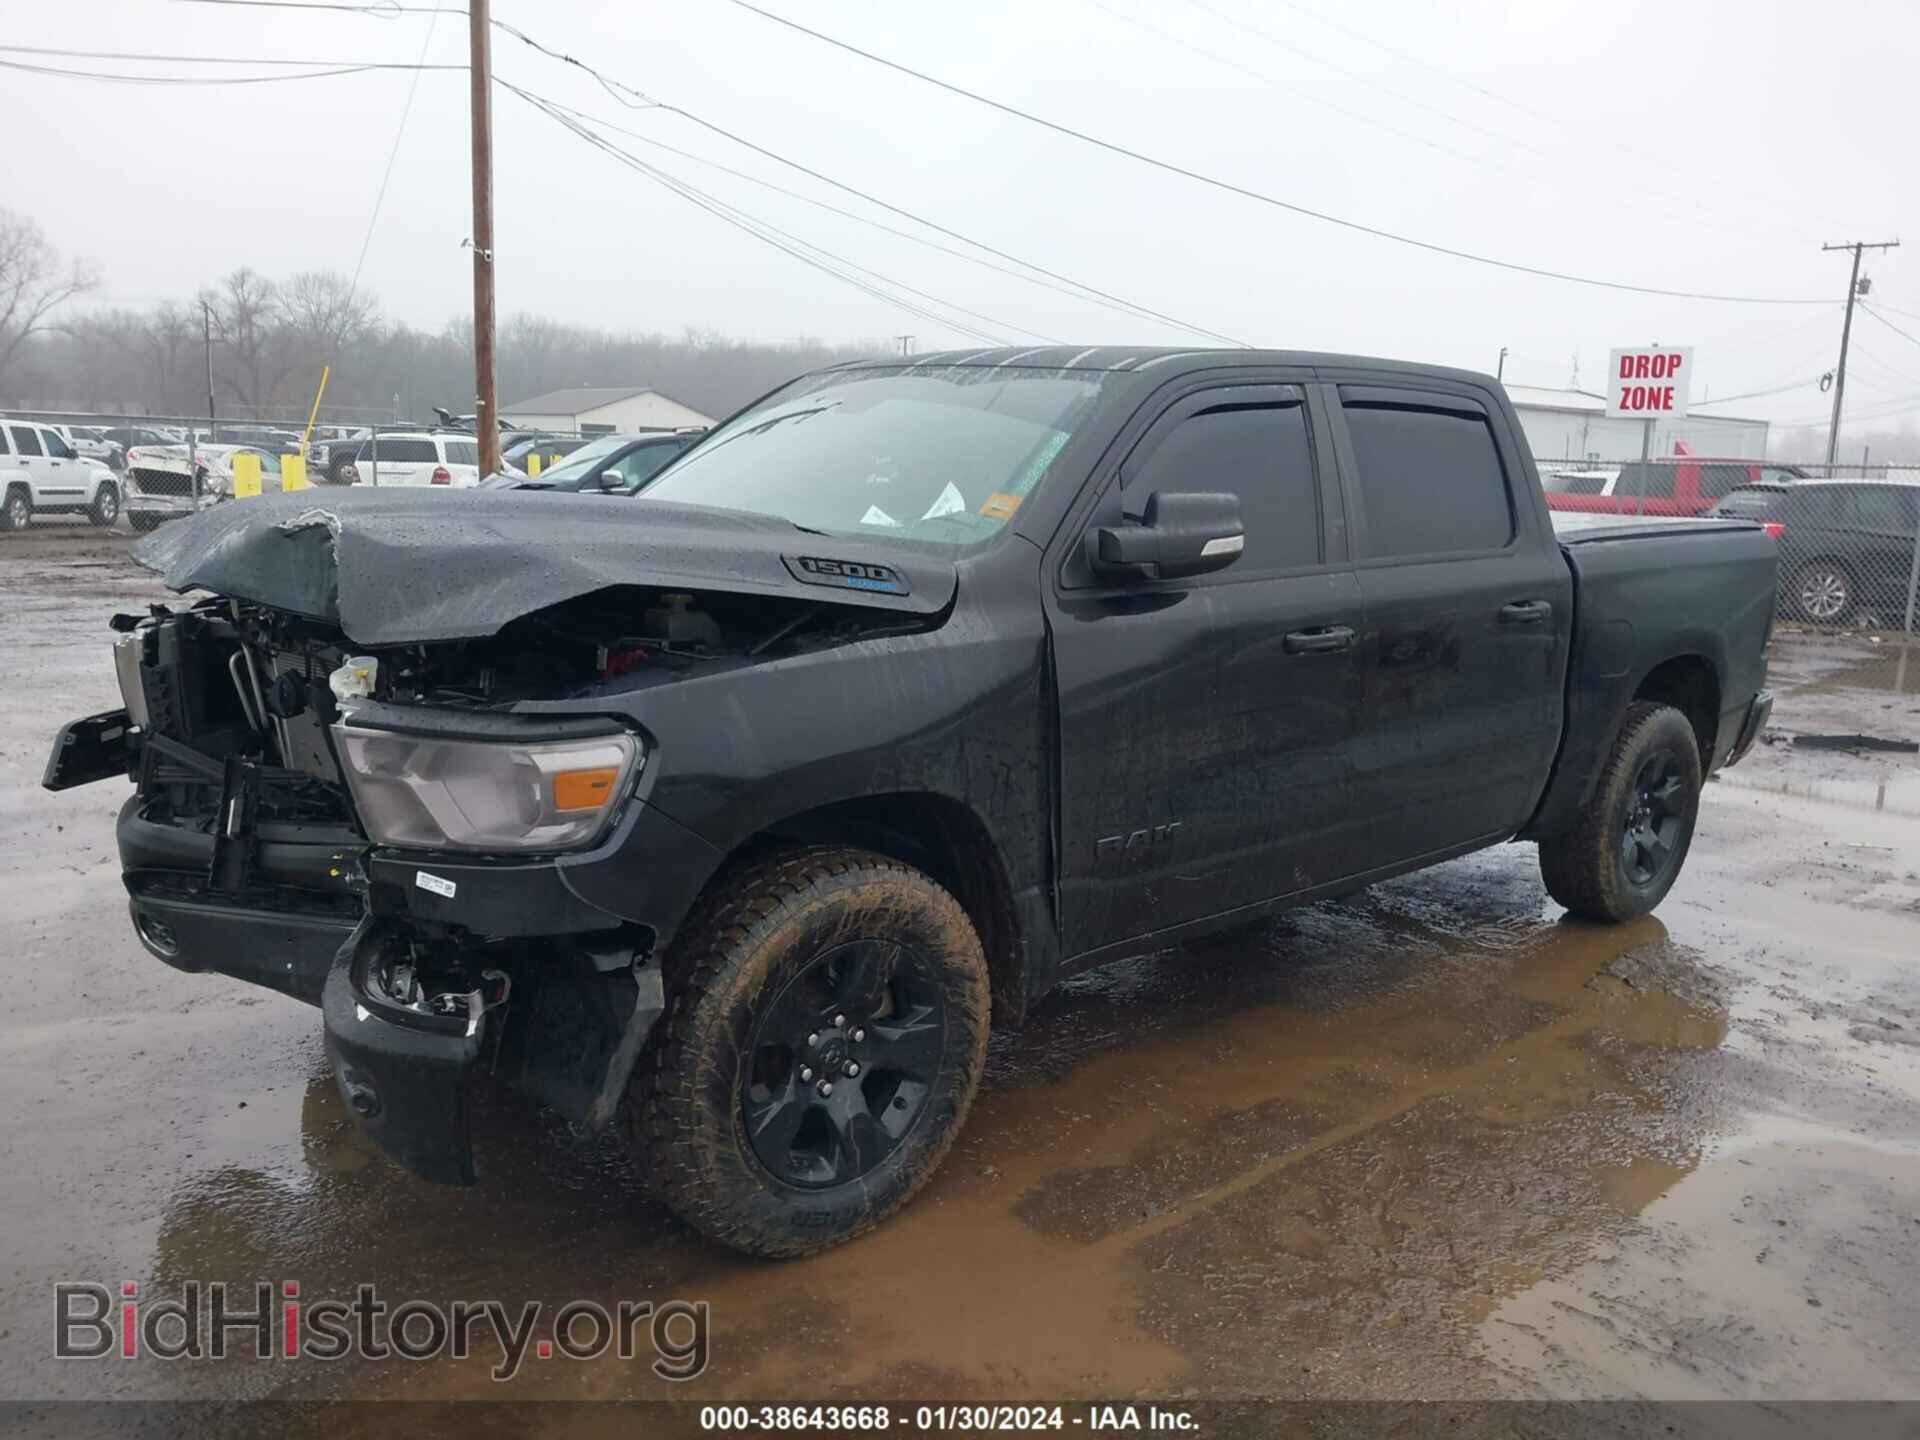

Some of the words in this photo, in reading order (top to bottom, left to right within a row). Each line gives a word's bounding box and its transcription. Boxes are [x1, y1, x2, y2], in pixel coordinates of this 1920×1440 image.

[1619, 354, 1682, 378] DROP
[1619, 386, 1674, 410] ZONE
[800, 558, 893, 580] 1500
